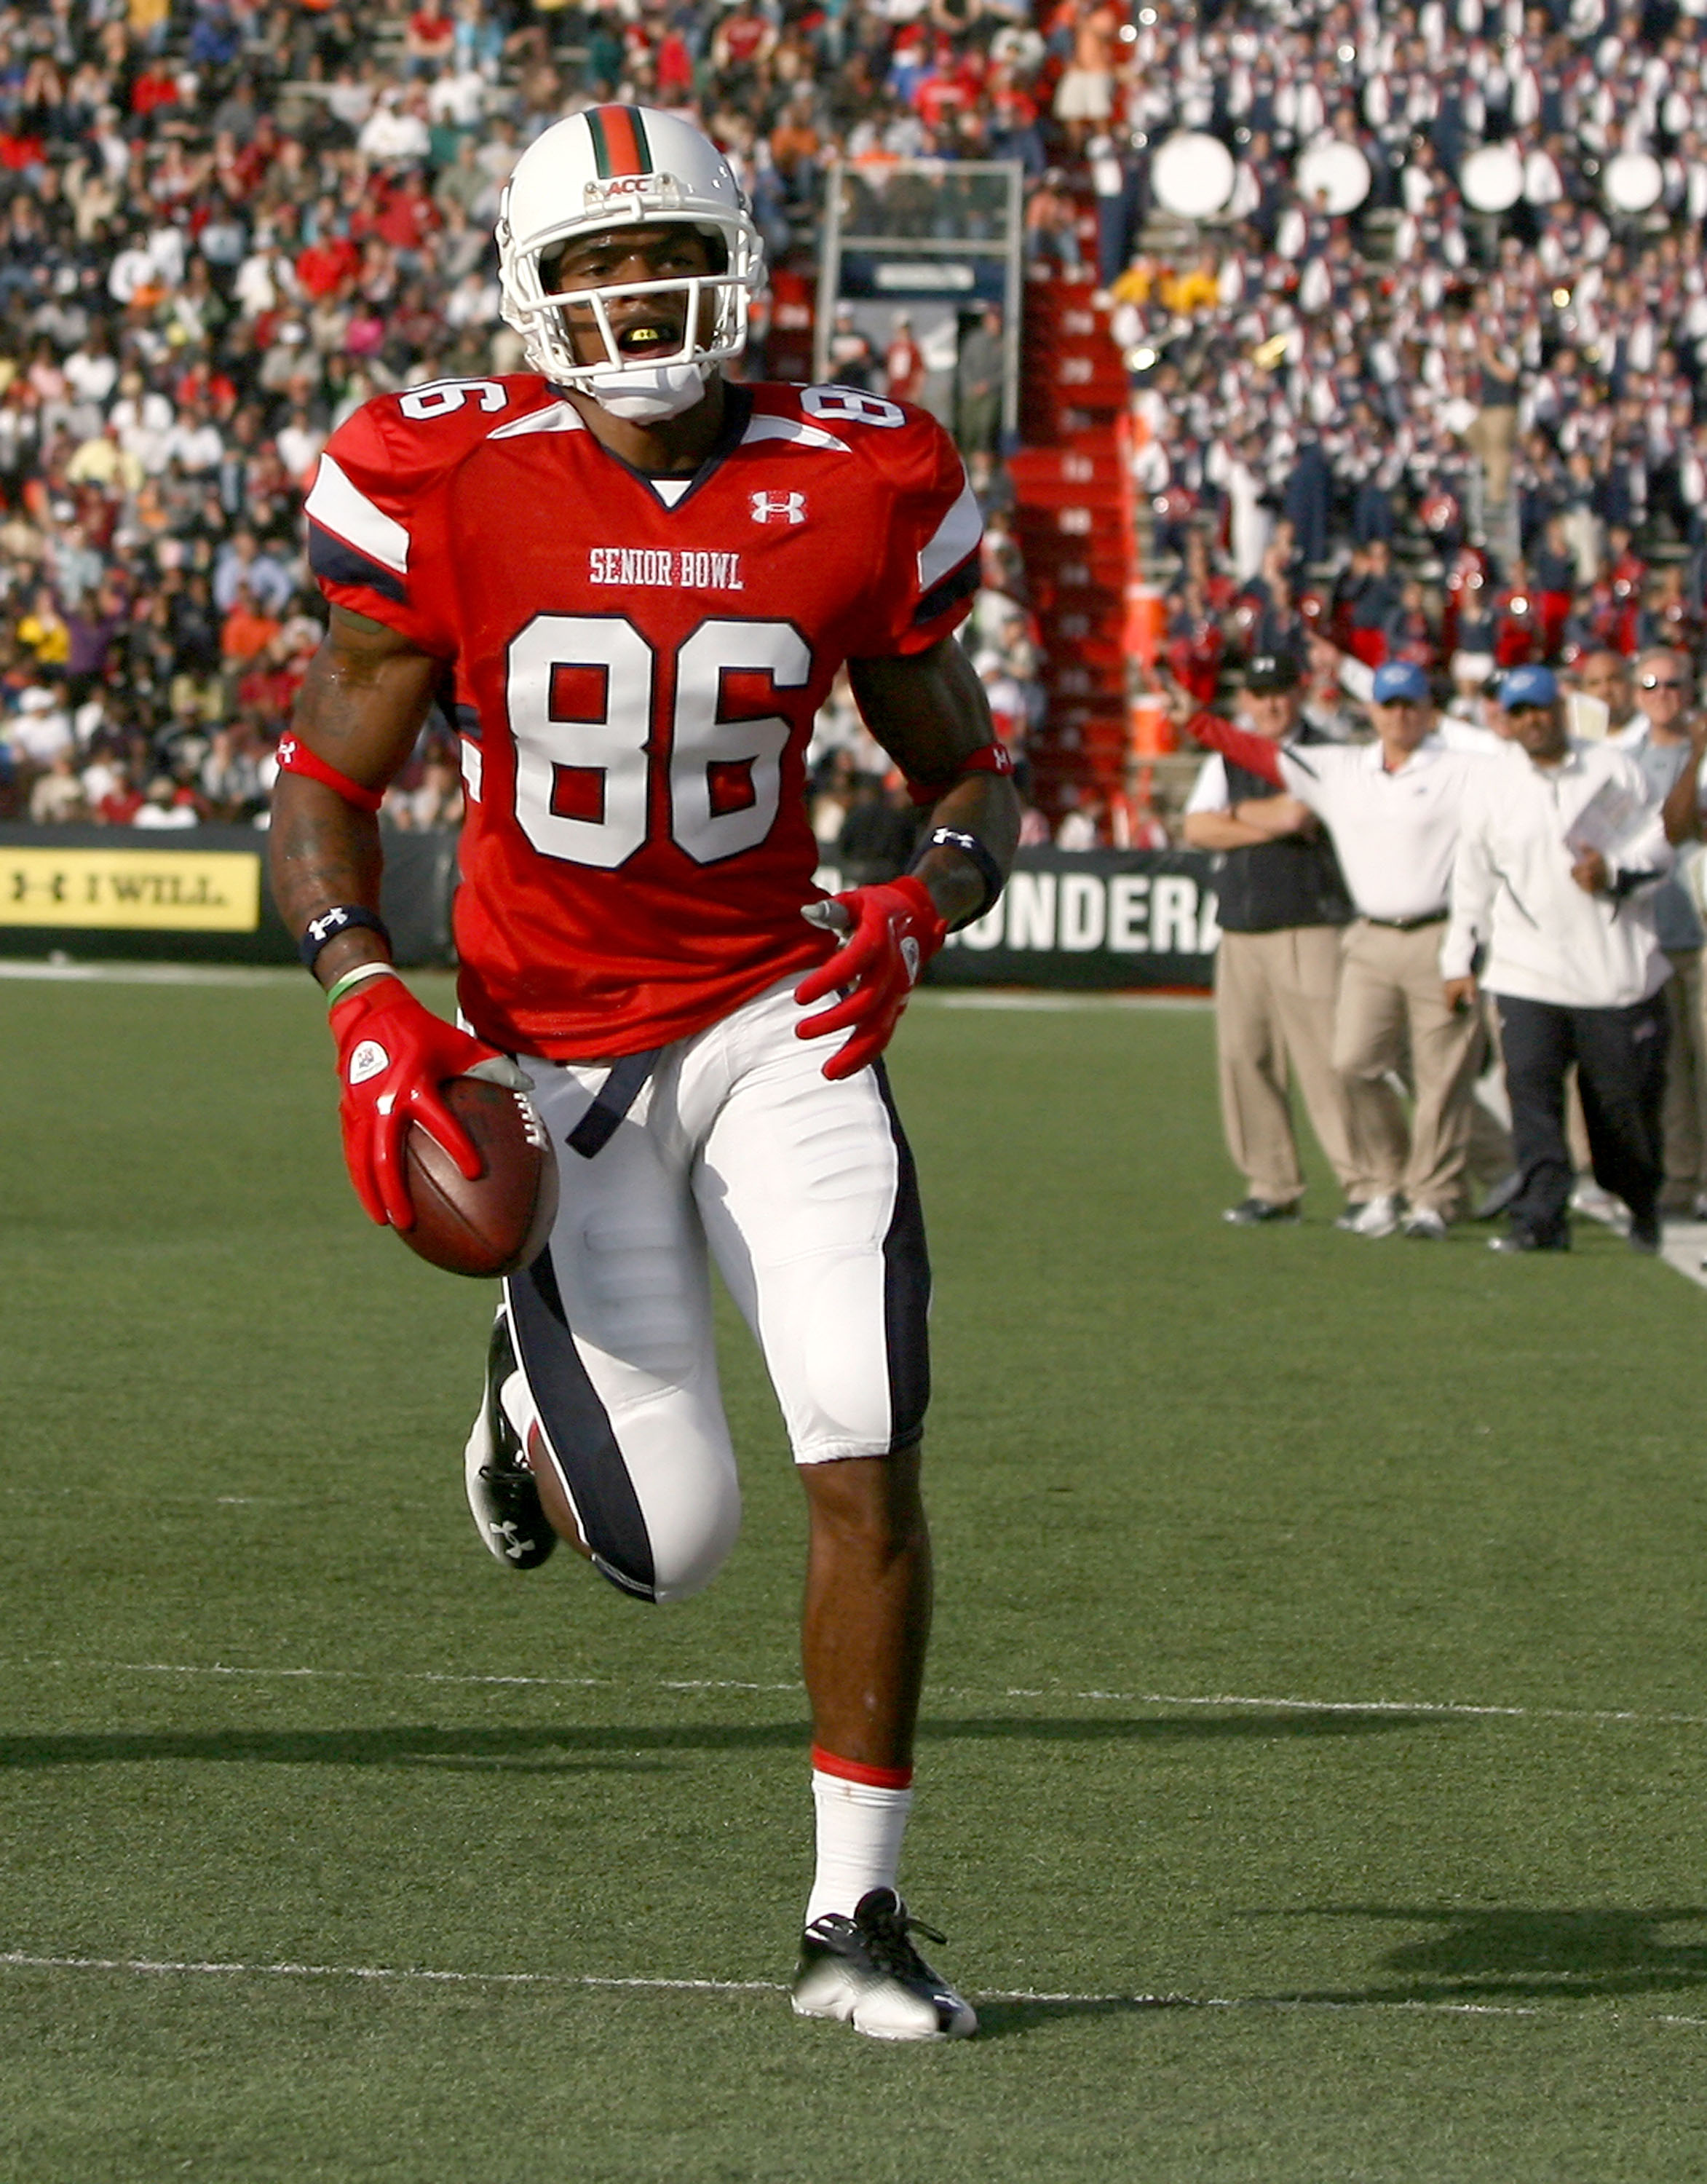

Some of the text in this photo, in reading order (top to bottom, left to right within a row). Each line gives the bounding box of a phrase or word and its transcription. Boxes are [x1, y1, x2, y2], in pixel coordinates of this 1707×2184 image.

[605, 178, 652, 197] ACC
[590, 547, 744, 590] SENIOR BOWL
[507, 613, 812, 869] 86
[86, 873, 100, 904] I
